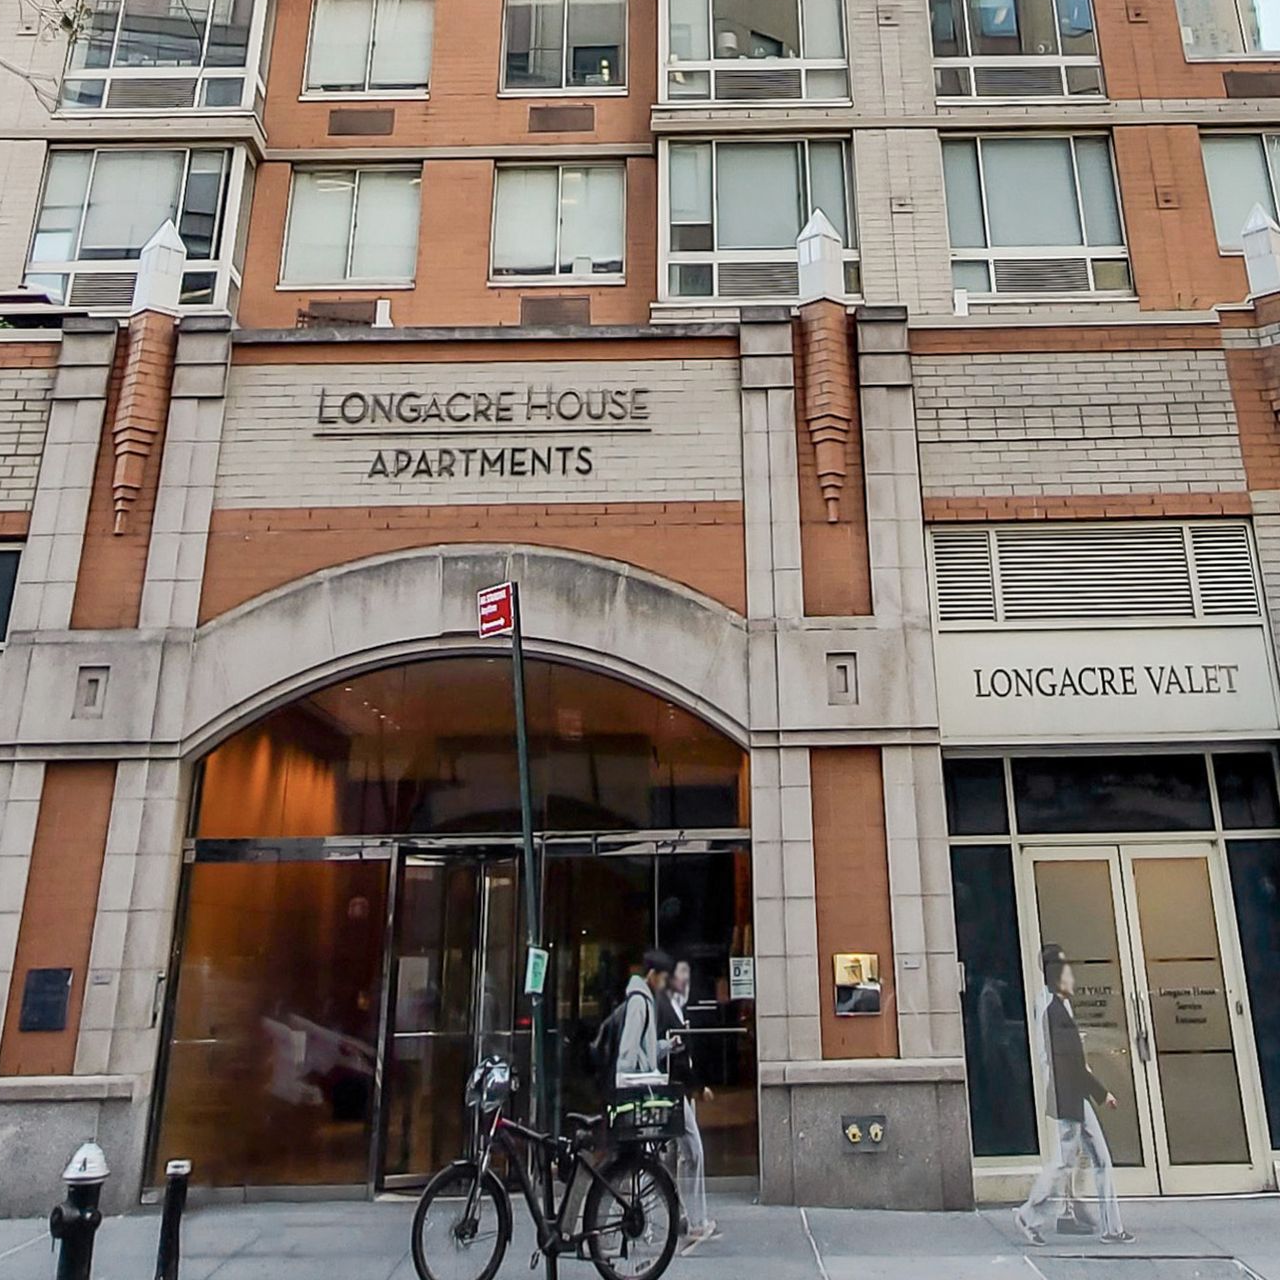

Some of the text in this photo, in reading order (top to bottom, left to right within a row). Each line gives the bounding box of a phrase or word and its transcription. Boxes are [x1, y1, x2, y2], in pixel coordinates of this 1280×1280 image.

[318, 383, 651, 424] LONGACRE HOUSE
[368, 446, 594, 479] APARTMENTS
[973, 664, 1239, 698] LONGACRE VALET
